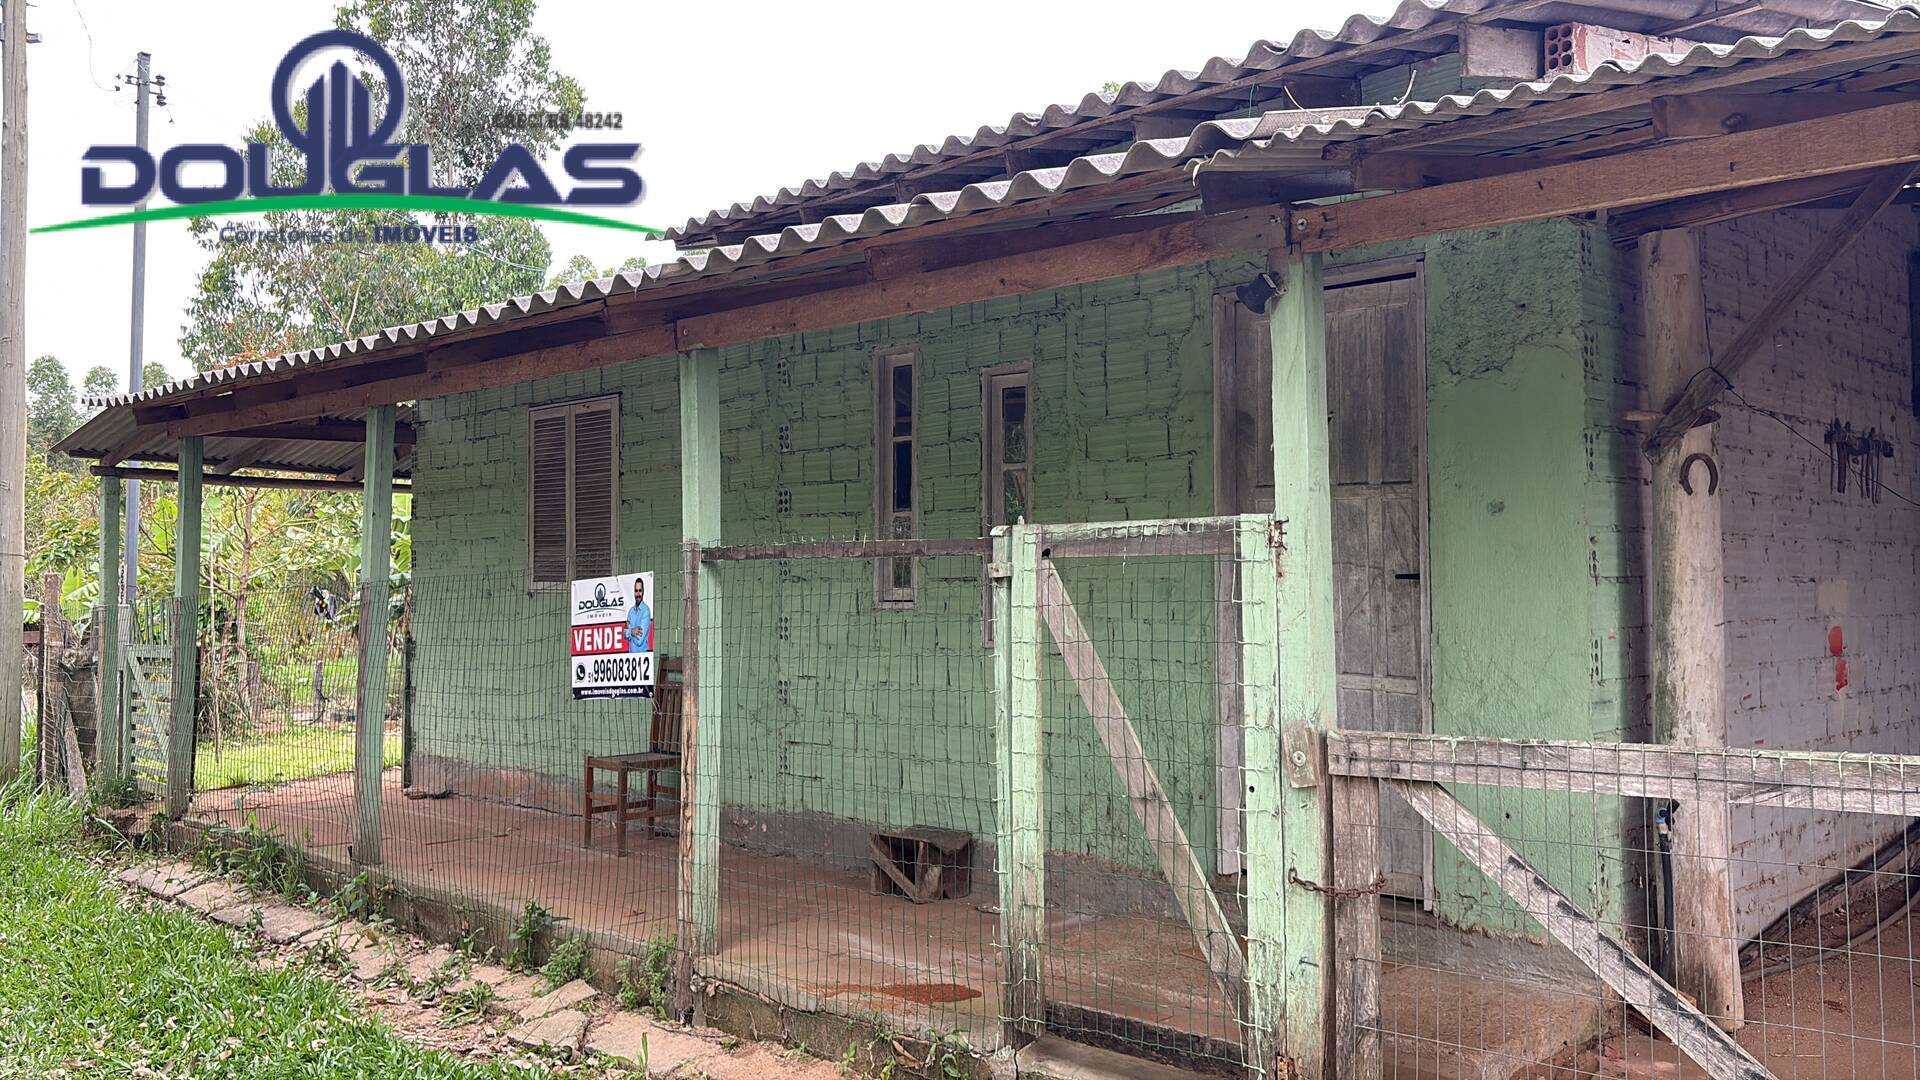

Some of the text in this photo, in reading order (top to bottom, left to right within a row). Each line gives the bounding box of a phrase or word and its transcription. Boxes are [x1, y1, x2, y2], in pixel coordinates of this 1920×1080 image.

[579, 597, 624, 610] DOUGLAS
[574, 626, 622, 651] VENDE
[594, 657, 650, 682] 996083812
